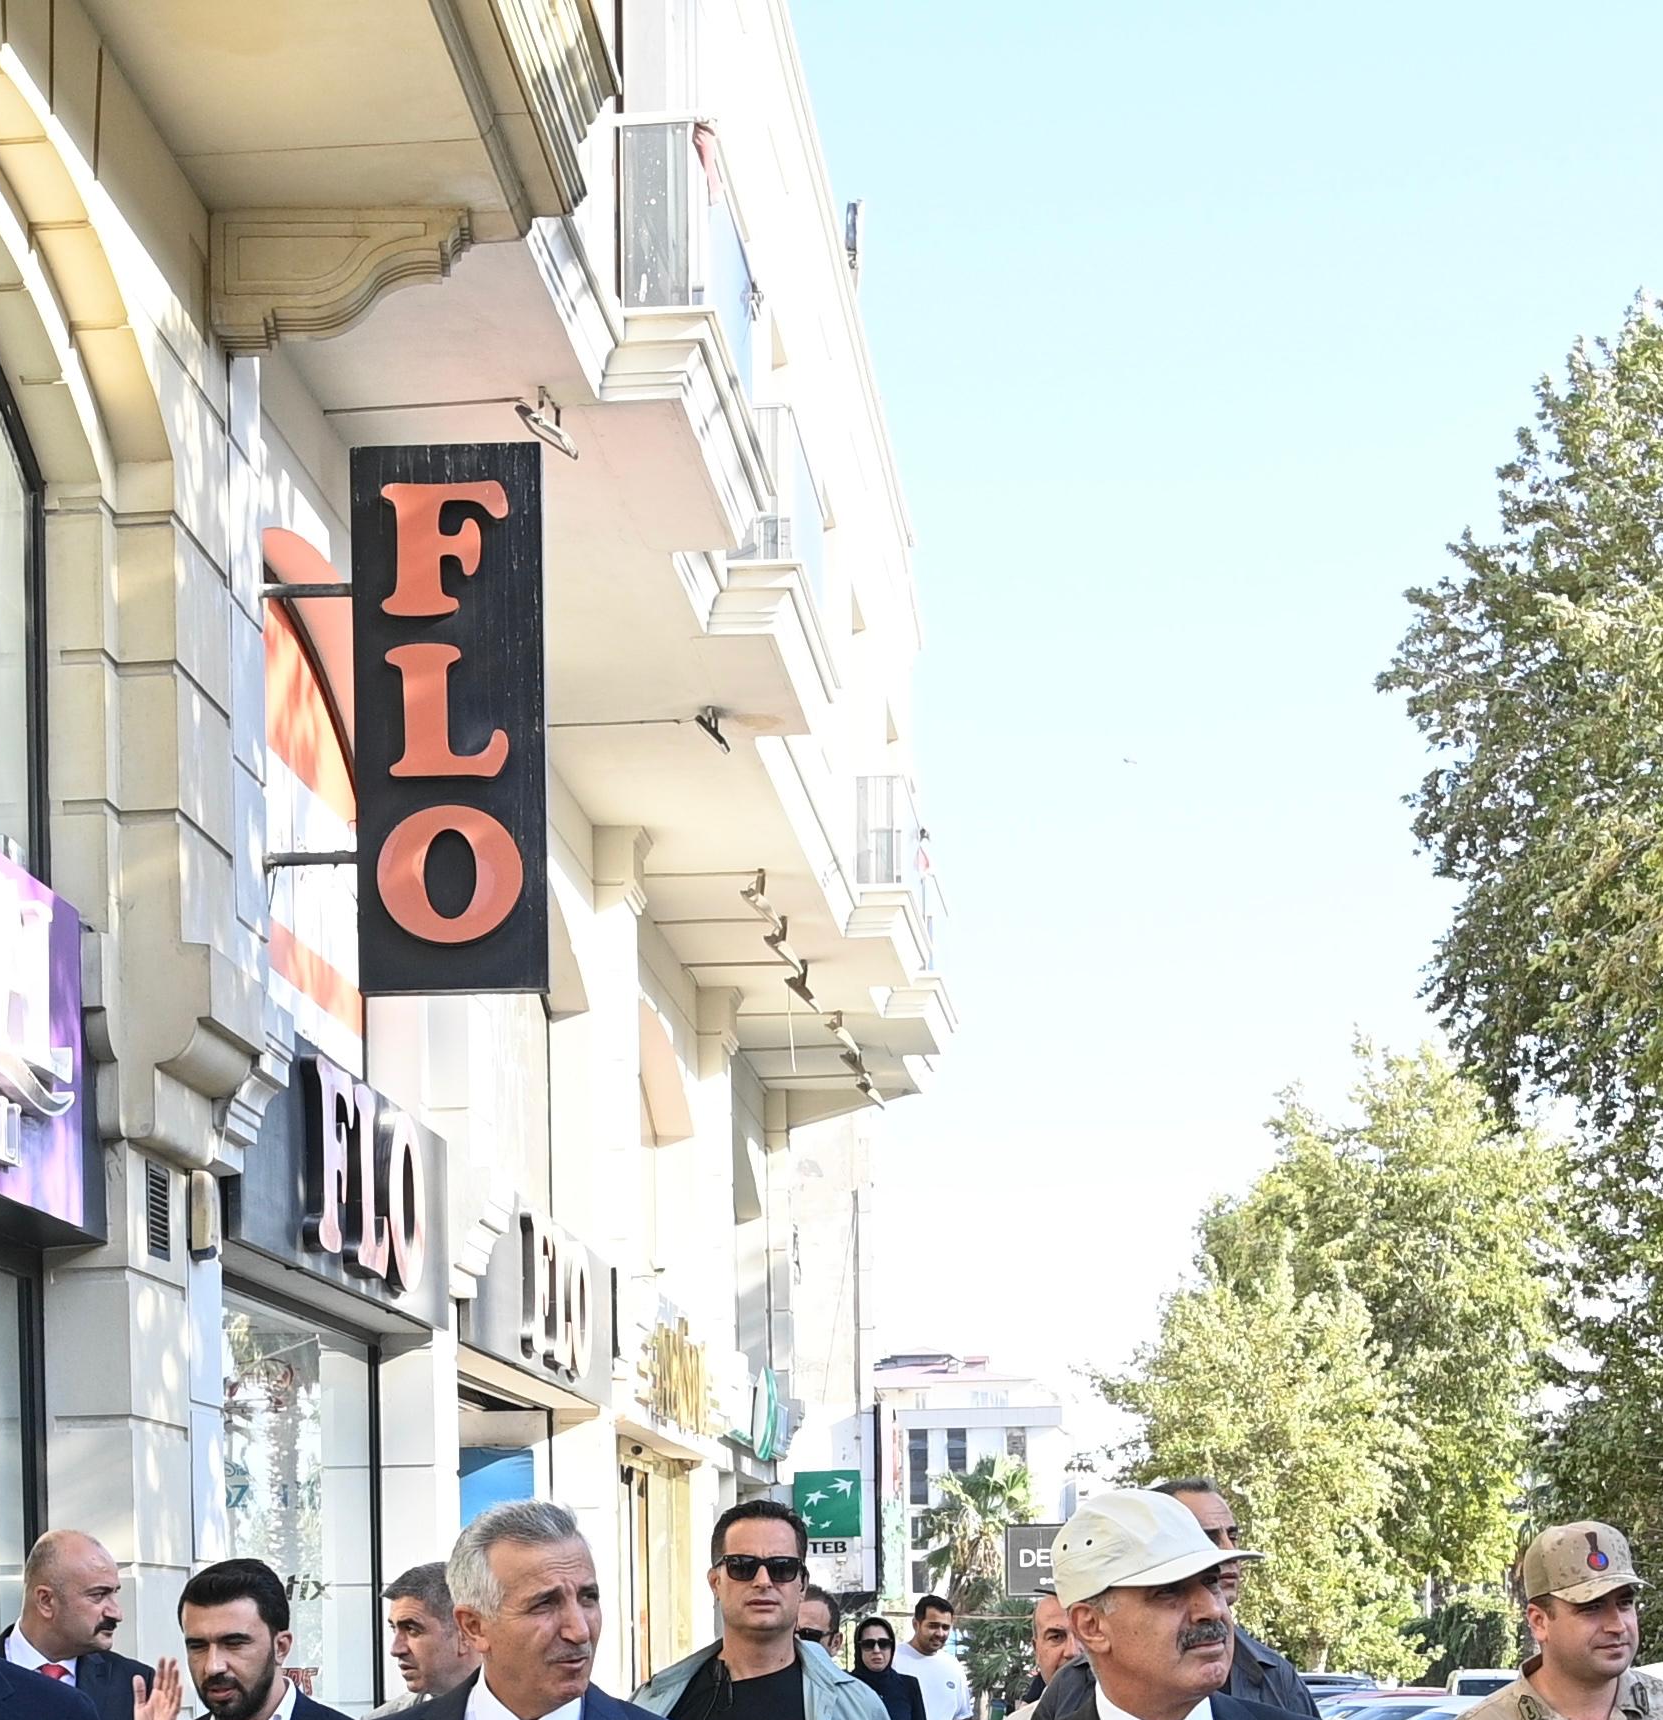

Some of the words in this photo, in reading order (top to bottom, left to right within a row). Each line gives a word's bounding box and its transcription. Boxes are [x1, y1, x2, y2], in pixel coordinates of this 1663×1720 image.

[377, 479, 524, 945] FLO
[305, 1053, 426, 1297] FLO
[520, 1213, 593, 1380] FLO
[809, 1540, 847, 1554] TEB
